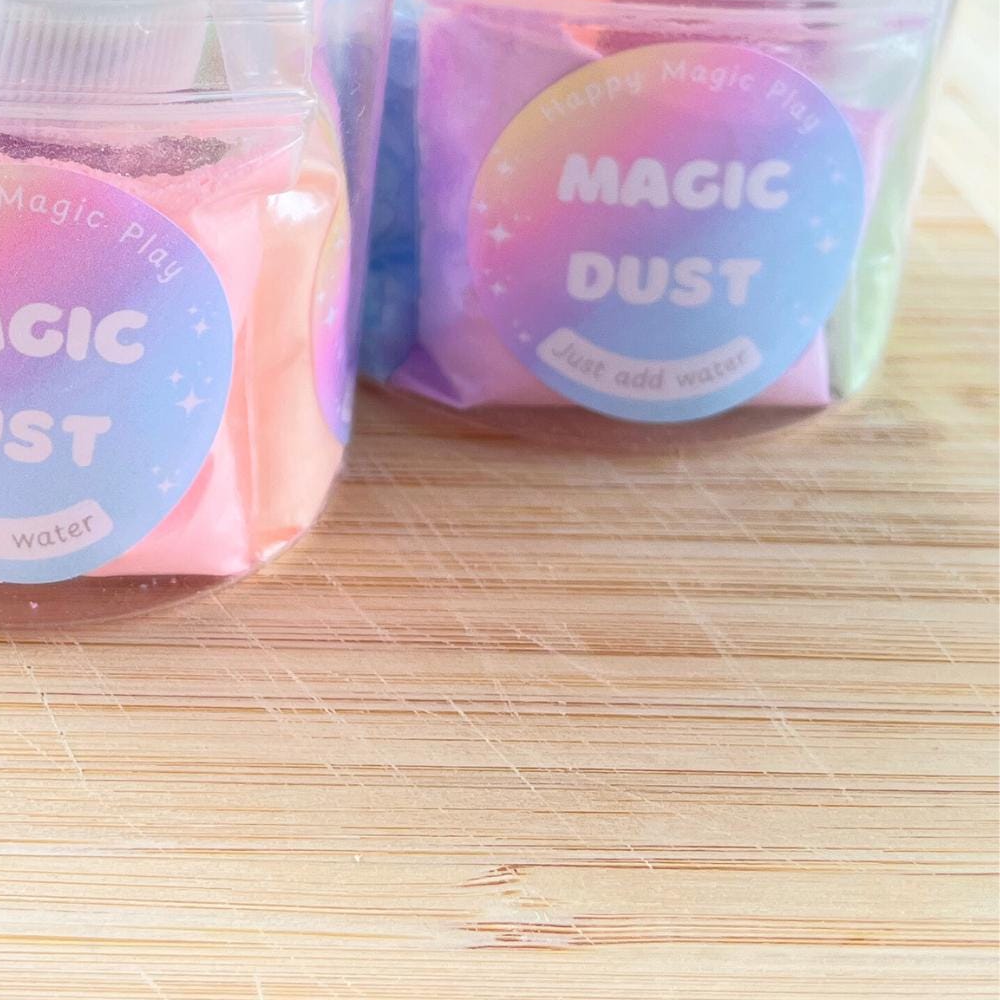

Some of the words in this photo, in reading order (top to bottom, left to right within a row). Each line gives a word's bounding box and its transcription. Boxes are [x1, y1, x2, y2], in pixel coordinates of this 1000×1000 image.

[541, 71, 645, 123] Happy
[660, 59, 755, 92] Magic
[765, 79, 821, 135] Play
[557, 153, 792, 211] MAGIC
[118, 221, 184, 284] Play
[566, 251, 763, 308] DUST
[552, 341, 605, 380] Just
[615, 367, 665, 391] add
[676, 348, 749, 388] water
[11, 512, 95, 549] water
